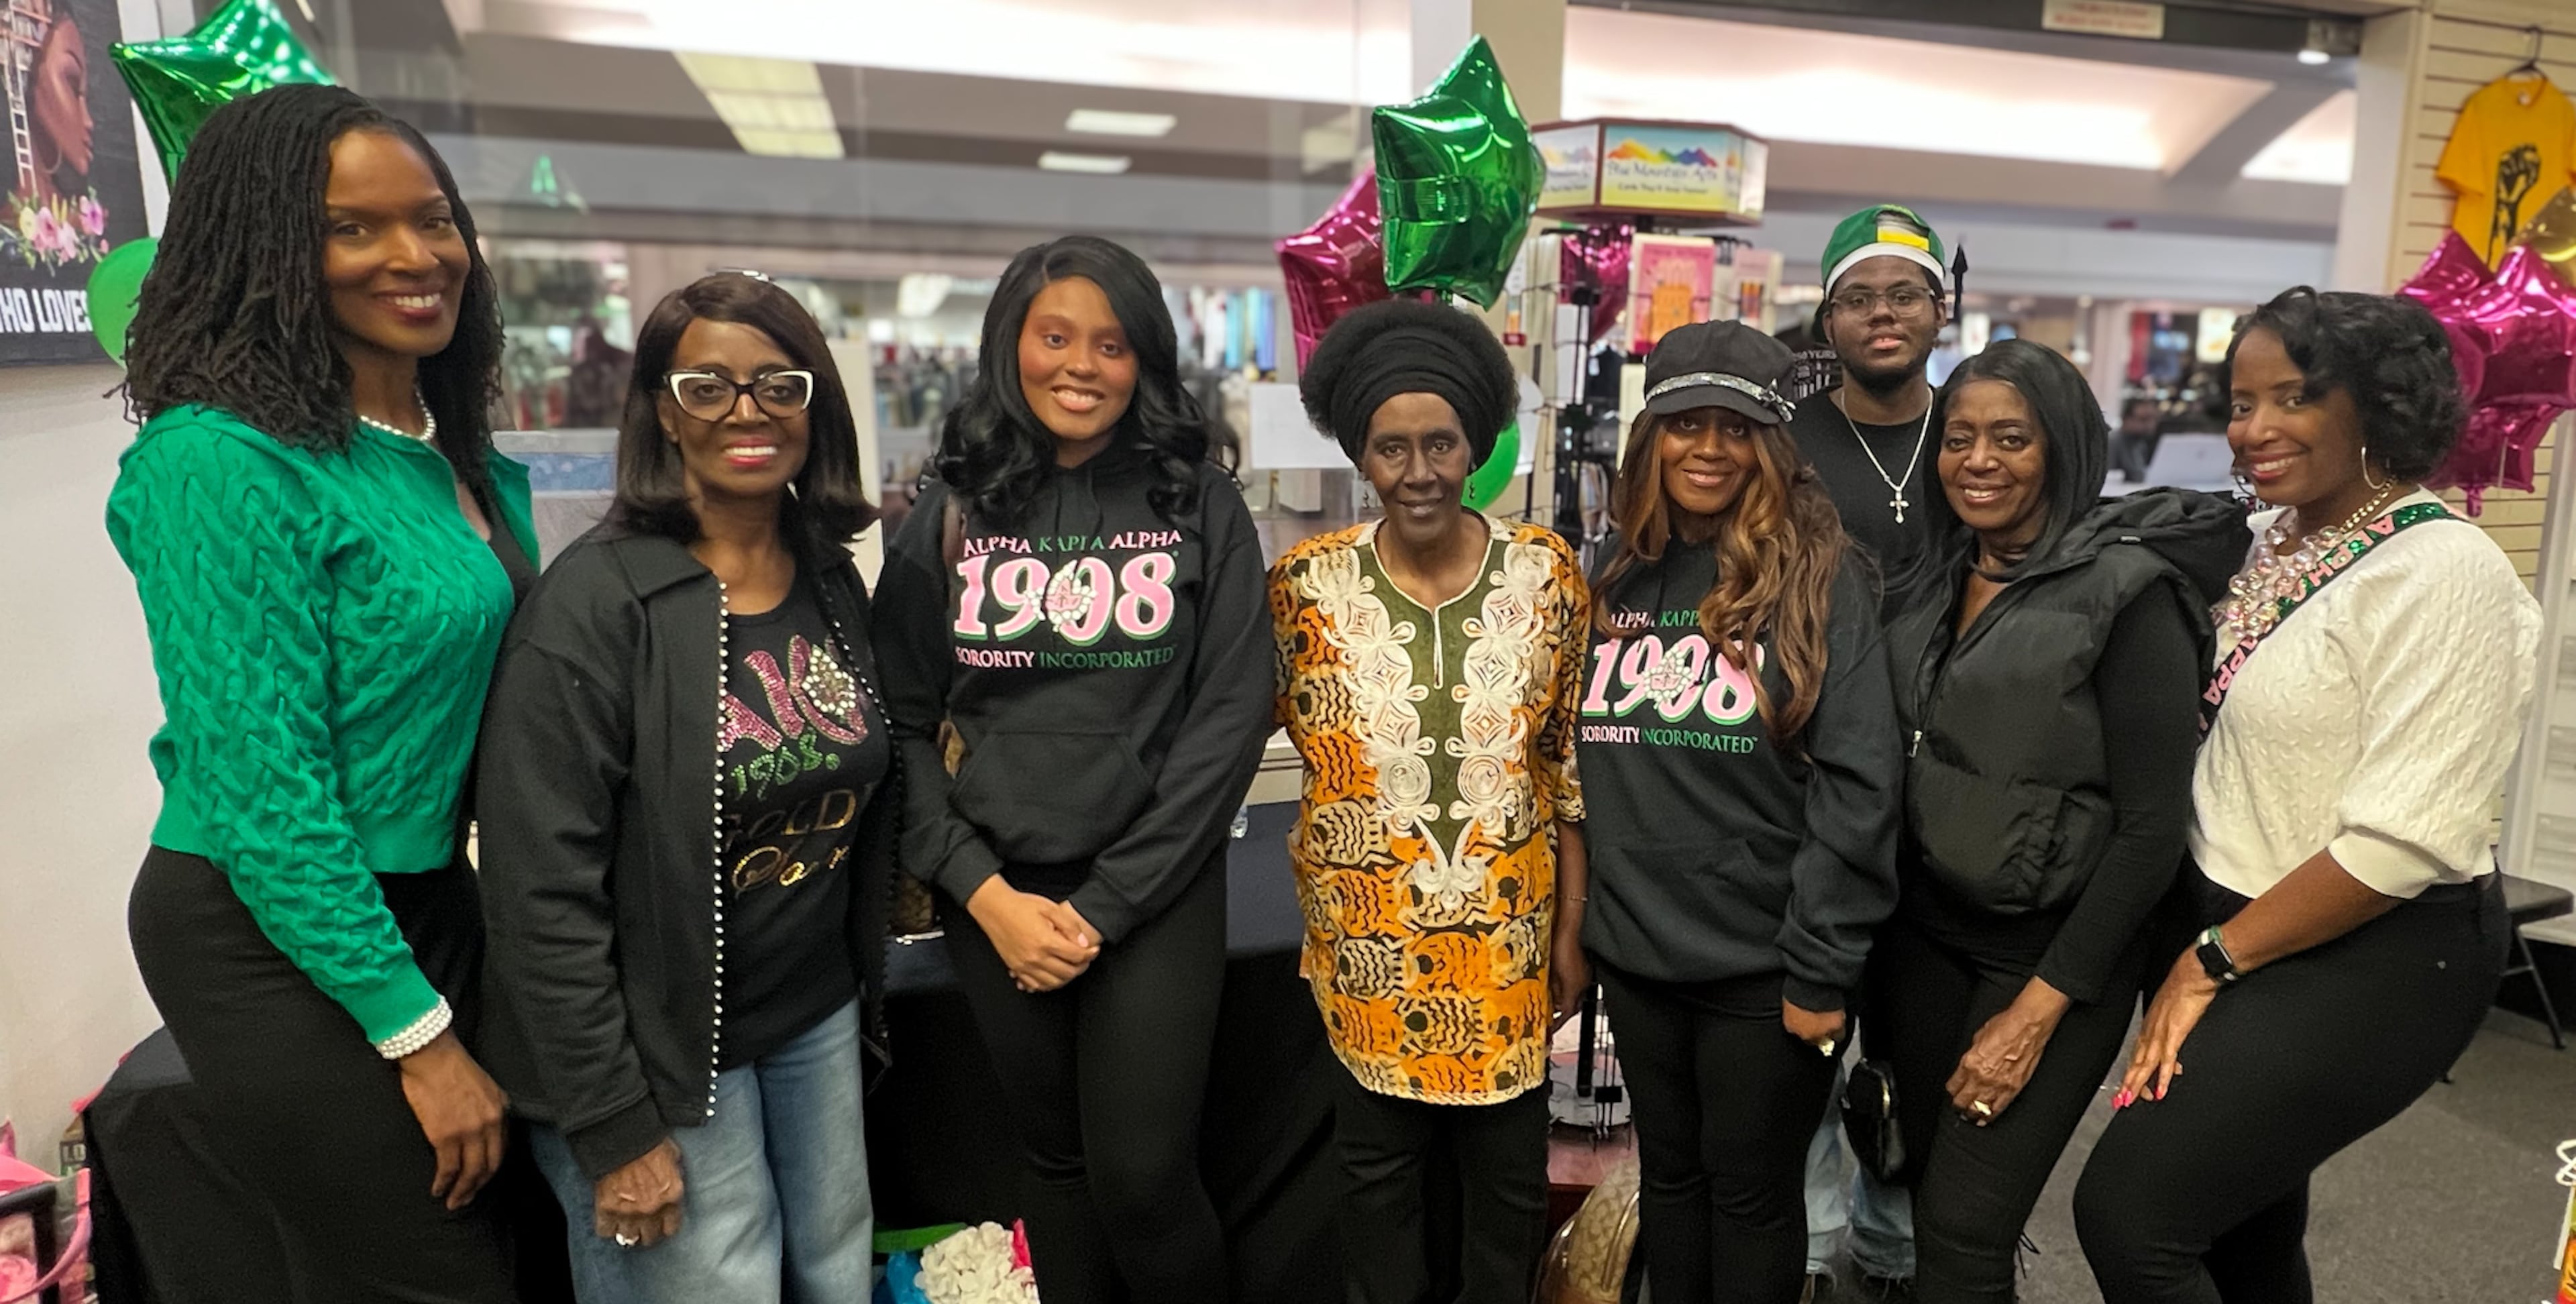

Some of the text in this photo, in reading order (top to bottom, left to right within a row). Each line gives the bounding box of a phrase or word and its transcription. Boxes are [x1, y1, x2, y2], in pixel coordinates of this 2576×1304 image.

[0, 287, 35, 333] HO
[963, 536, 1032, 557] ALPHA
[1109, 529, 1183, 549] ALPHA
[954, 551, 1177, 647] 1908
[1660, 610, 1700, 627] KAPP
[955, 646, 1174, 669] SORORITY INCORPORATED
[2202, 634, 2259, 706] APPA
[1580, 634, 1765, 726] 1908
[1581, 725, 1754, 754] SORORITY NCORPORATED
